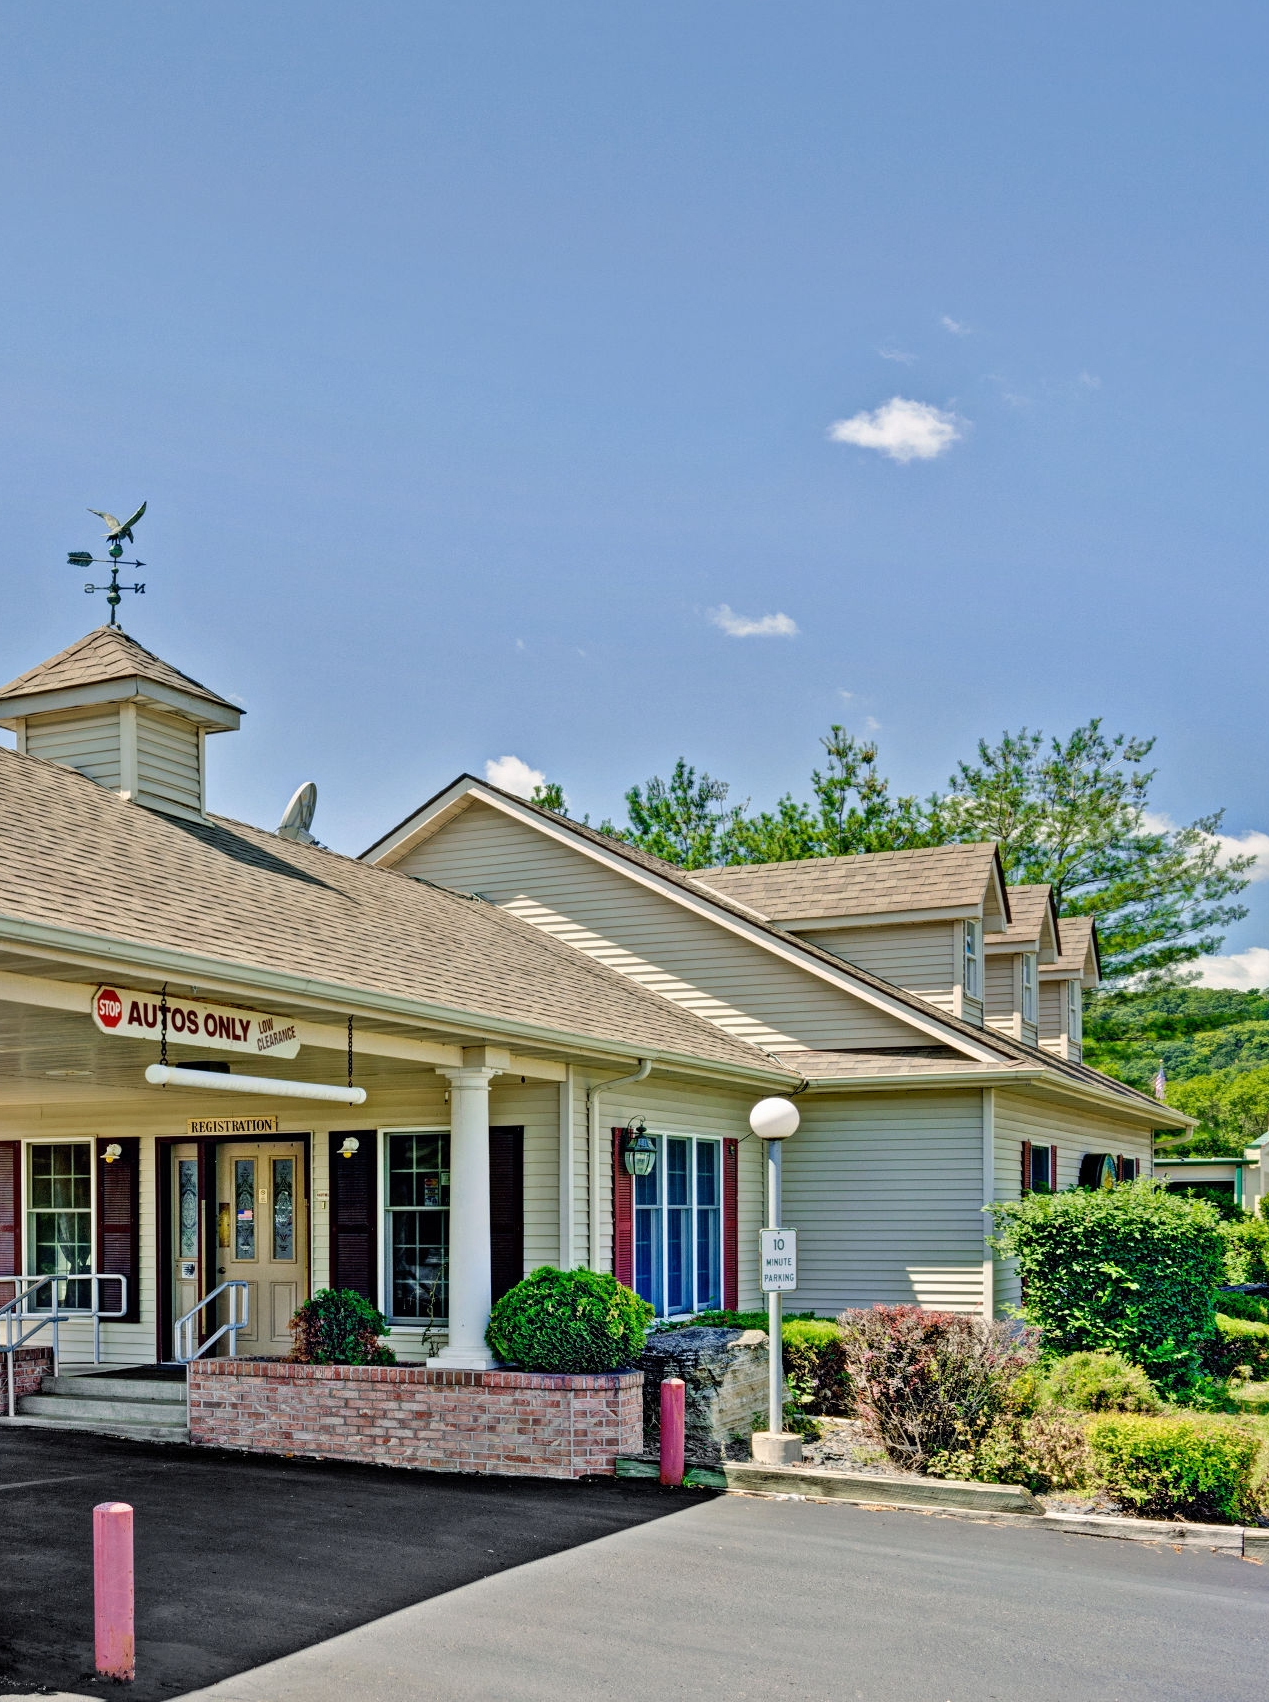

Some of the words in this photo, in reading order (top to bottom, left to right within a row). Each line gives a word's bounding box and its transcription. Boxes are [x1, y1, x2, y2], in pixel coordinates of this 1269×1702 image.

[99, 999, 121, 1017] STOP
[128, 1000, 199, 1035] AUTOS
[204, 1013, 251, 1042] ONLY
[258, 1017, 274, 1035] LOW
[257, 1025, 297, 1052] CLEARANCE
[191, 1119, 272, 1133] REGISTRATION
[773, 1238, 785, 1251] 10
[766, 1258, 792, 1266] MINUTE
[764, 1273, 794, 1282] PARKING
